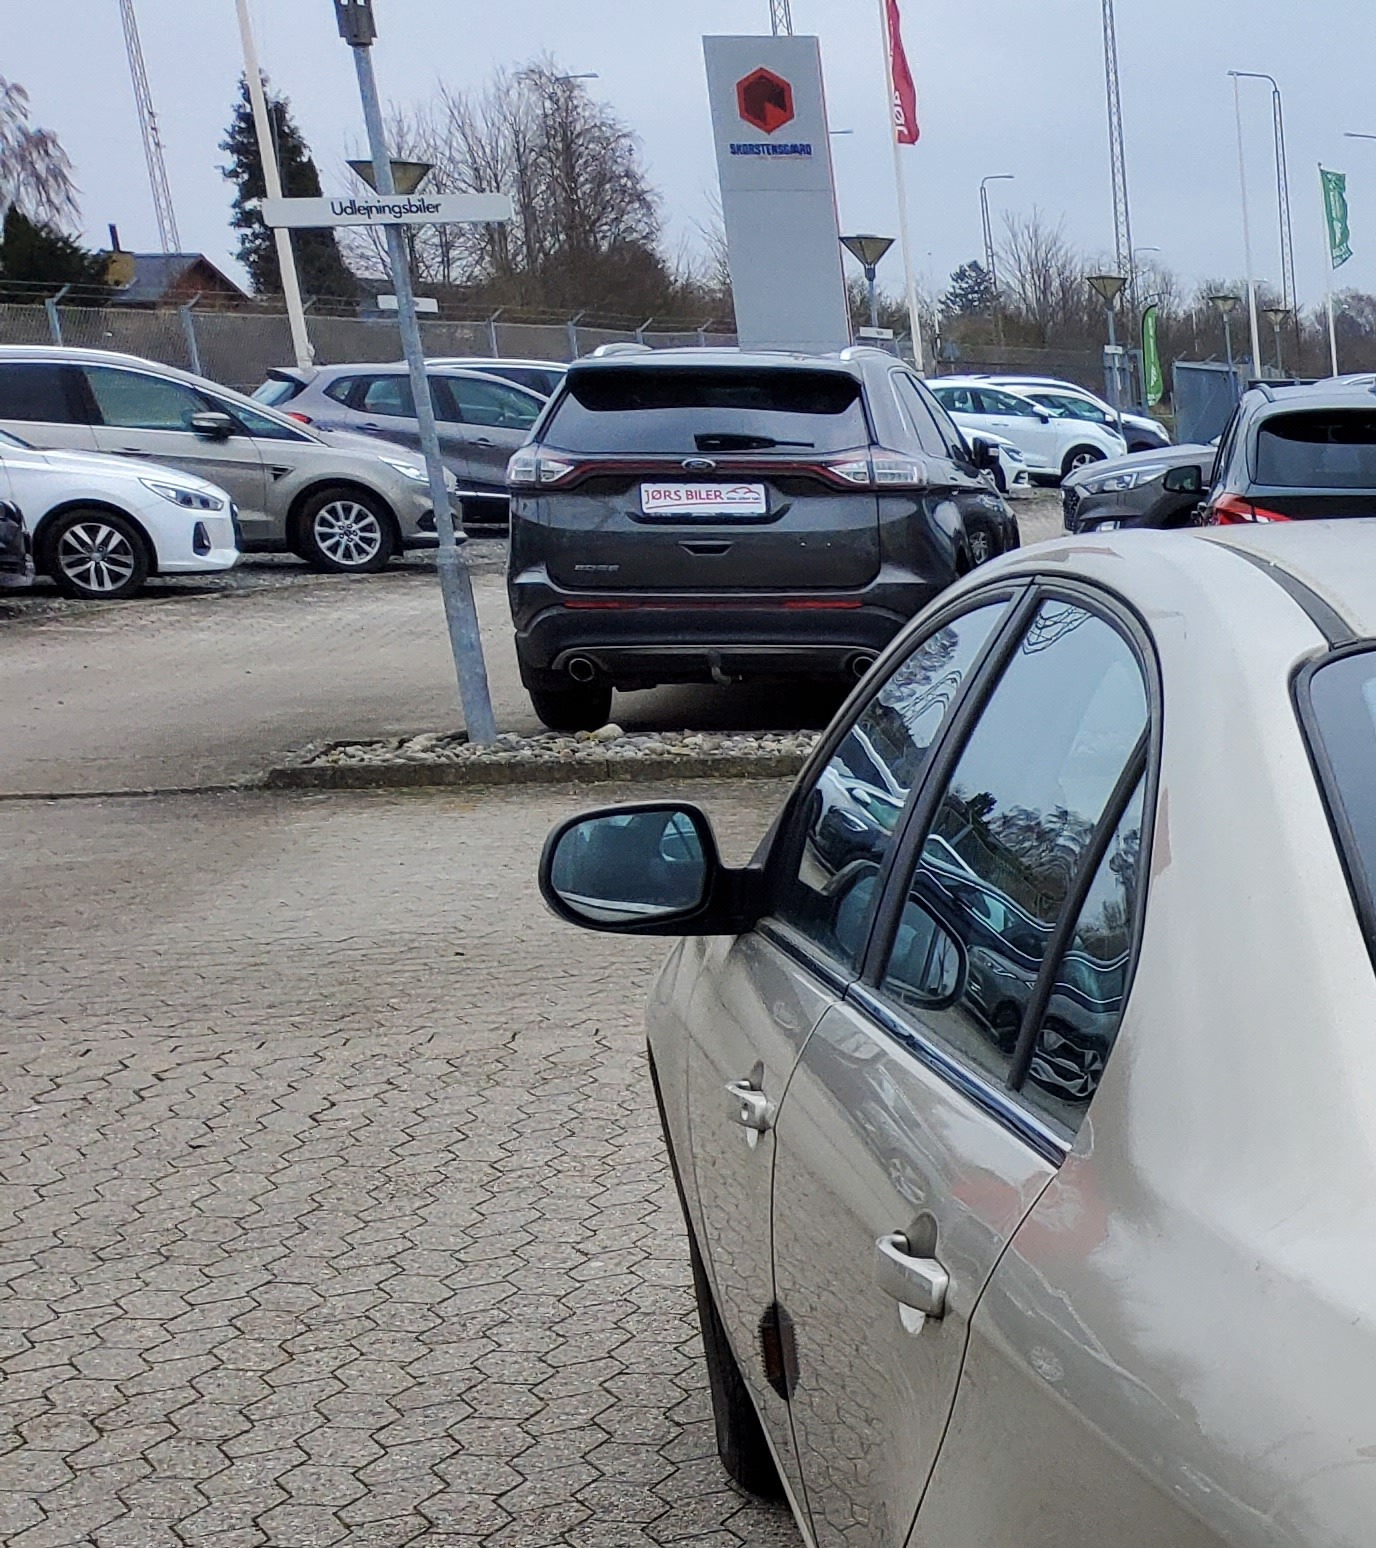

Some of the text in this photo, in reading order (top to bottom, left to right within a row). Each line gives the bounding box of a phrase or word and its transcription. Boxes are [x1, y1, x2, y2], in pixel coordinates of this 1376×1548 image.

[331, 197, 442, 220] Udlejningsbiler
[644, 489, 724, 504] JØRS BILER
